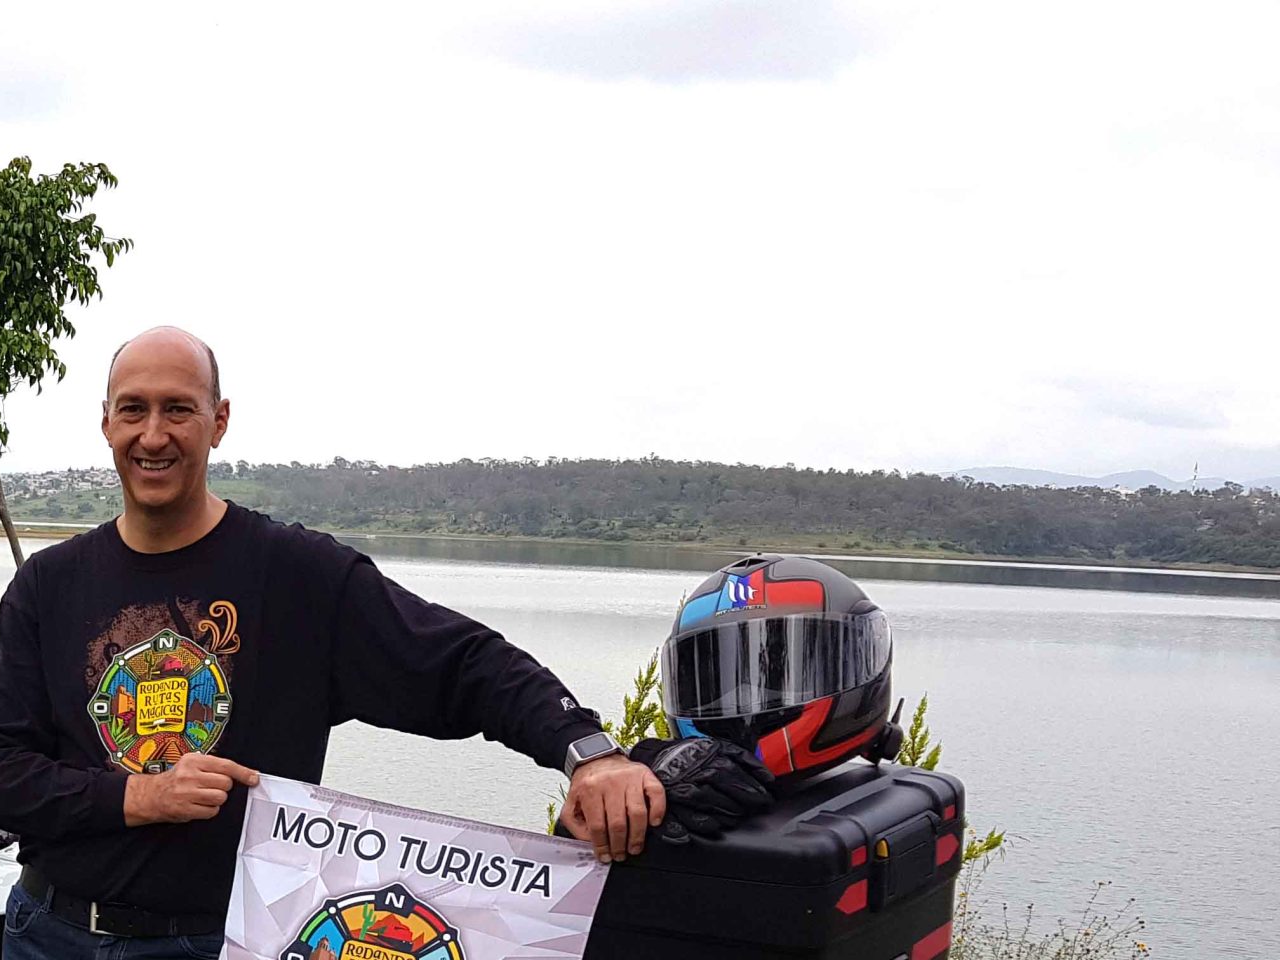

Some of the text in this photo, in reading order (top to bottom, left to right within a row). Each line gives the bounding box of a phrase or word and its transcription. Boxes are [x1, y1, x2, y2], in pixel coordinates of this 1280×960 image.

[160, 637, 173, 648] N
[93, 702, 108, 713] O
[217, 703, 229, 714] E
[272, 807, 552, 898] MOTO TURISTA
[384, 892, 405, 909] N
